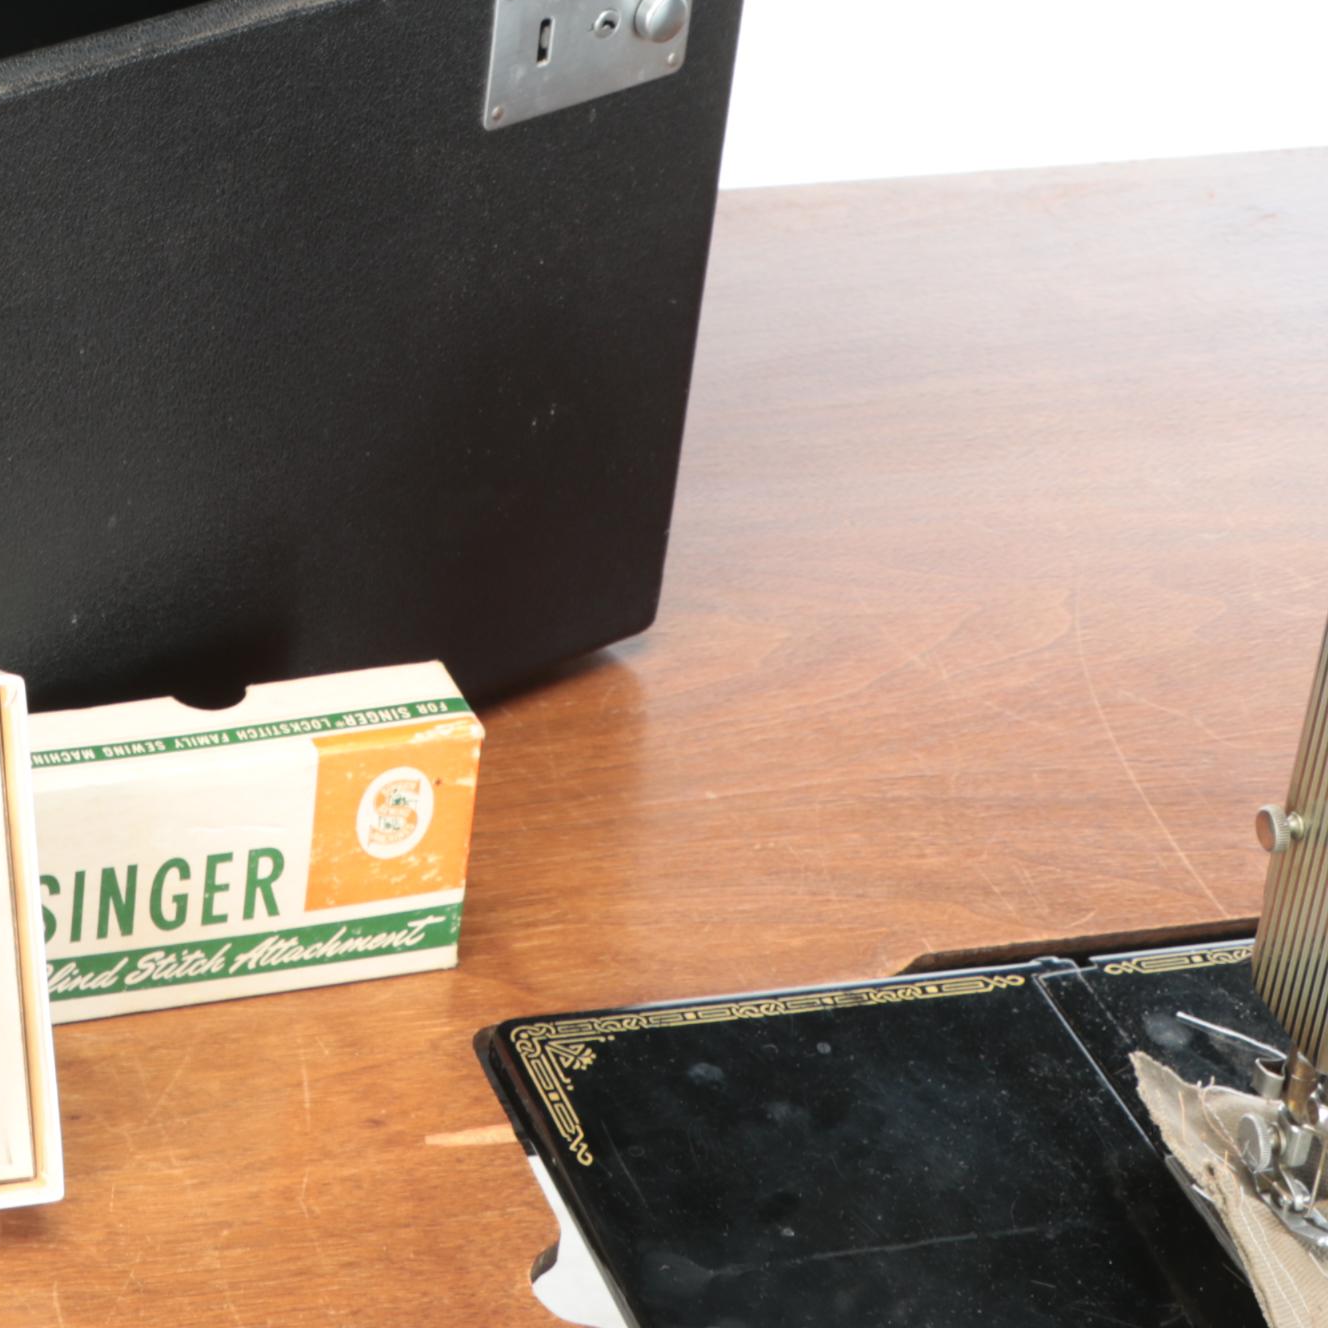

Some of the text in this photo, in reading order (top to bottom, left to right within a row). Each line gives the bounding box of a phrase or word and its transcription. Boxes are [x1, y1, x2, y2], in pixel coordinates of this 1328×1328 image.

[416, 700, 449, 714] FOR
[236, 717, 332, 741] LOCKSTITCH
[174, 730, 231, 749] FAMILY
[31, 748, 96, 766] MACHIN
[102, 740, 166, 759] SEWING
[124, 942, 233, 986] Stitch
[234, 914, 447, 974] Attachment
